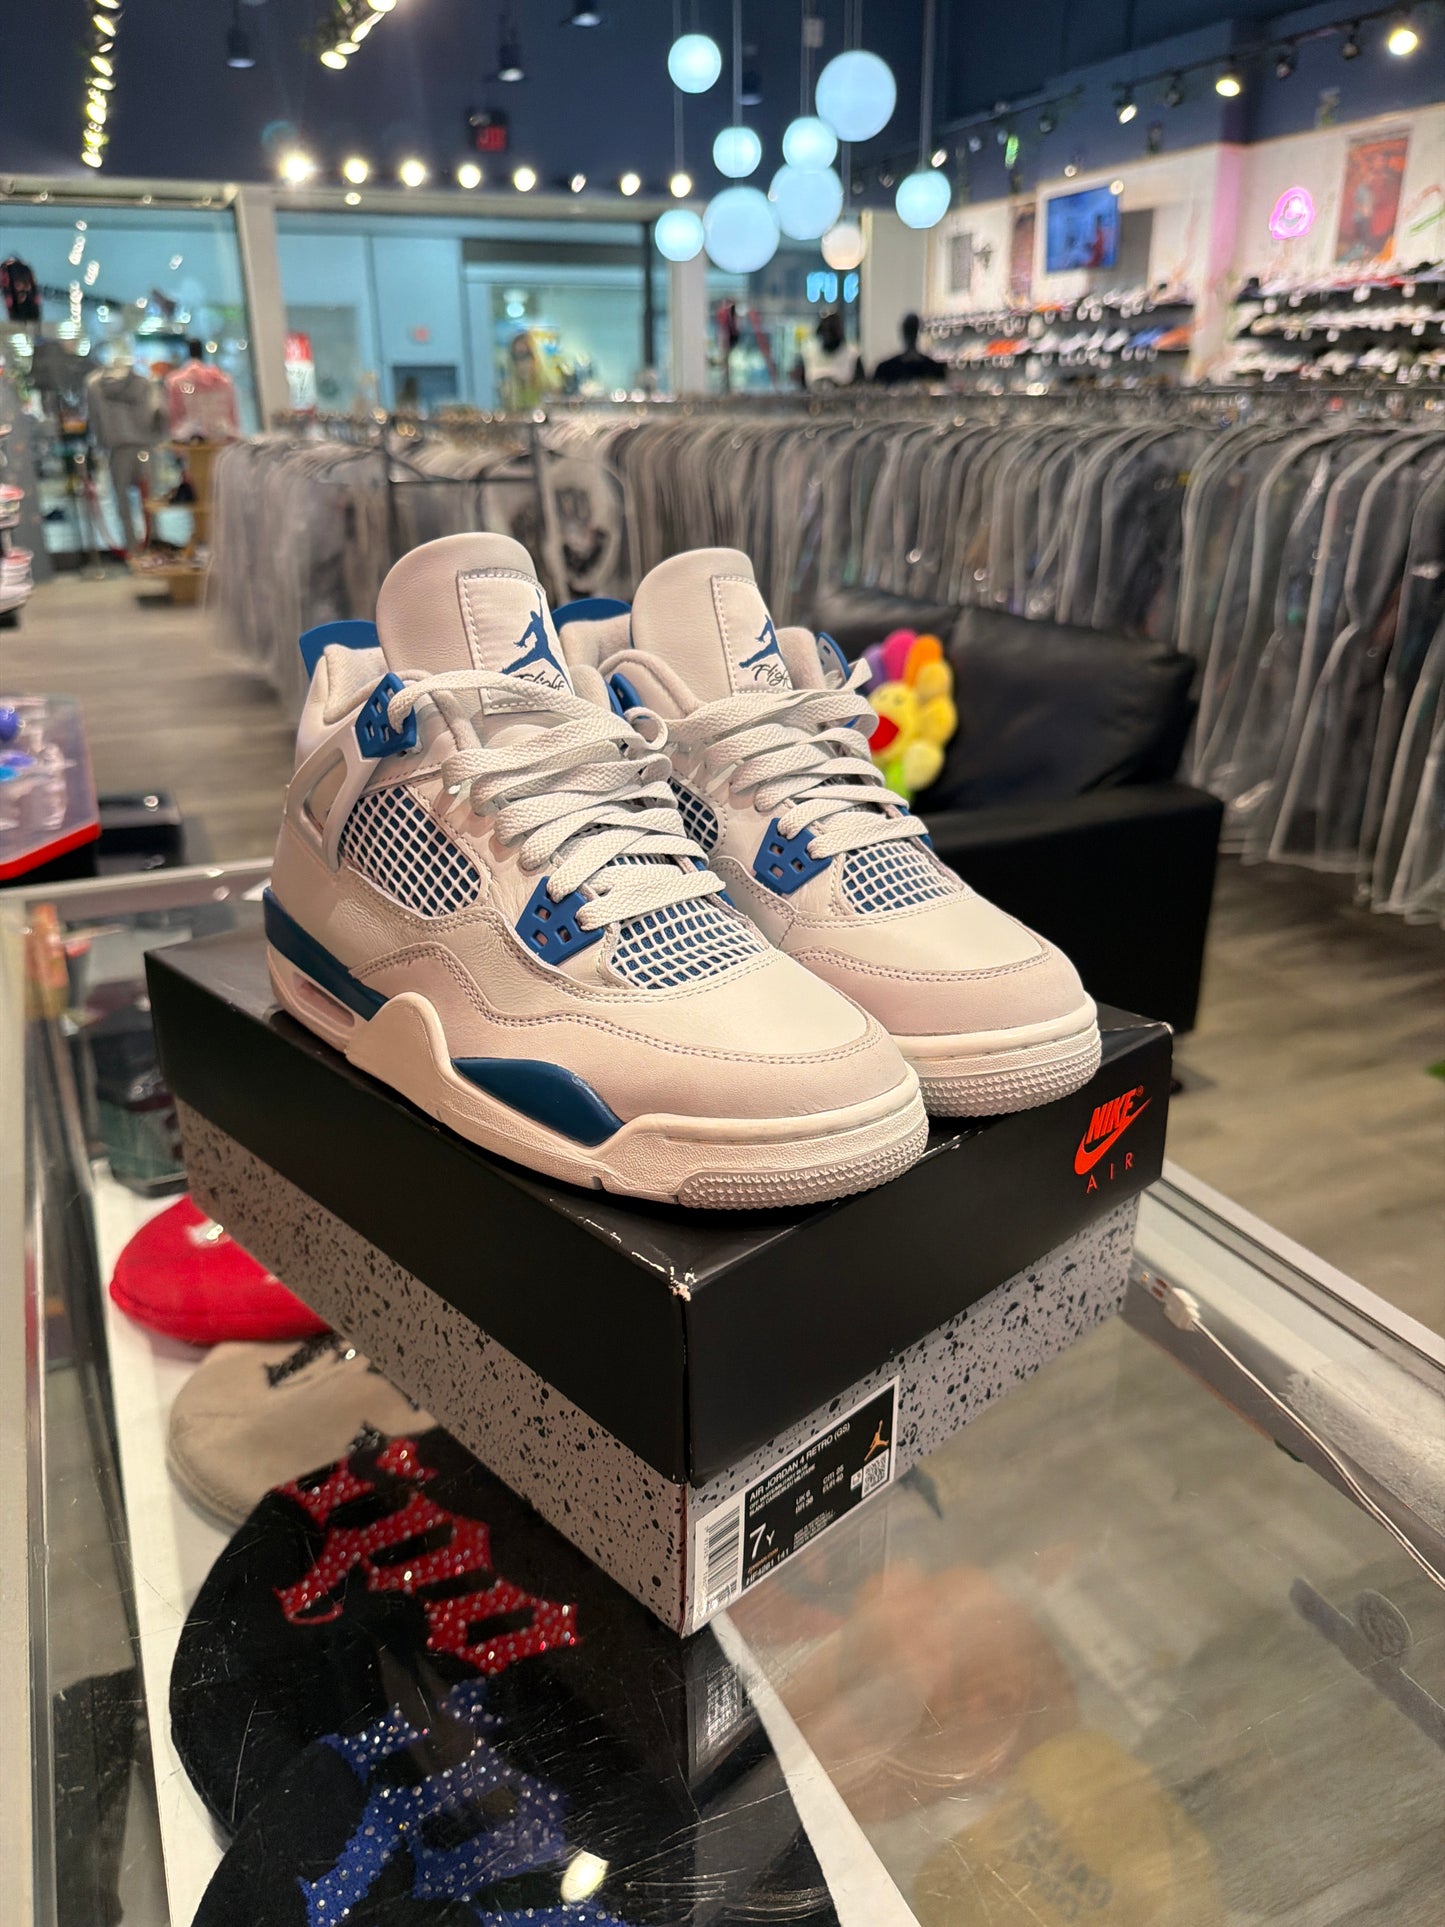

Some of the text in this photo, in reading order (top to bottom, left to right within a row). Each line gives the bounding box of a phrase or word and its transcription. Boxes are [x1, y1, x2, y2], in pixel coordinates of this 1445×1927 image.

[513, 670, 565, 691] Flht
[751, 663, 791, 690] Flig
[1085, 1088, 1138, 1145] NIKE
[1086, 1152, 1133, 1194] AIR
[749, 1422, 850, 1502] AIR JORDAN 4 RETRO (GS)
